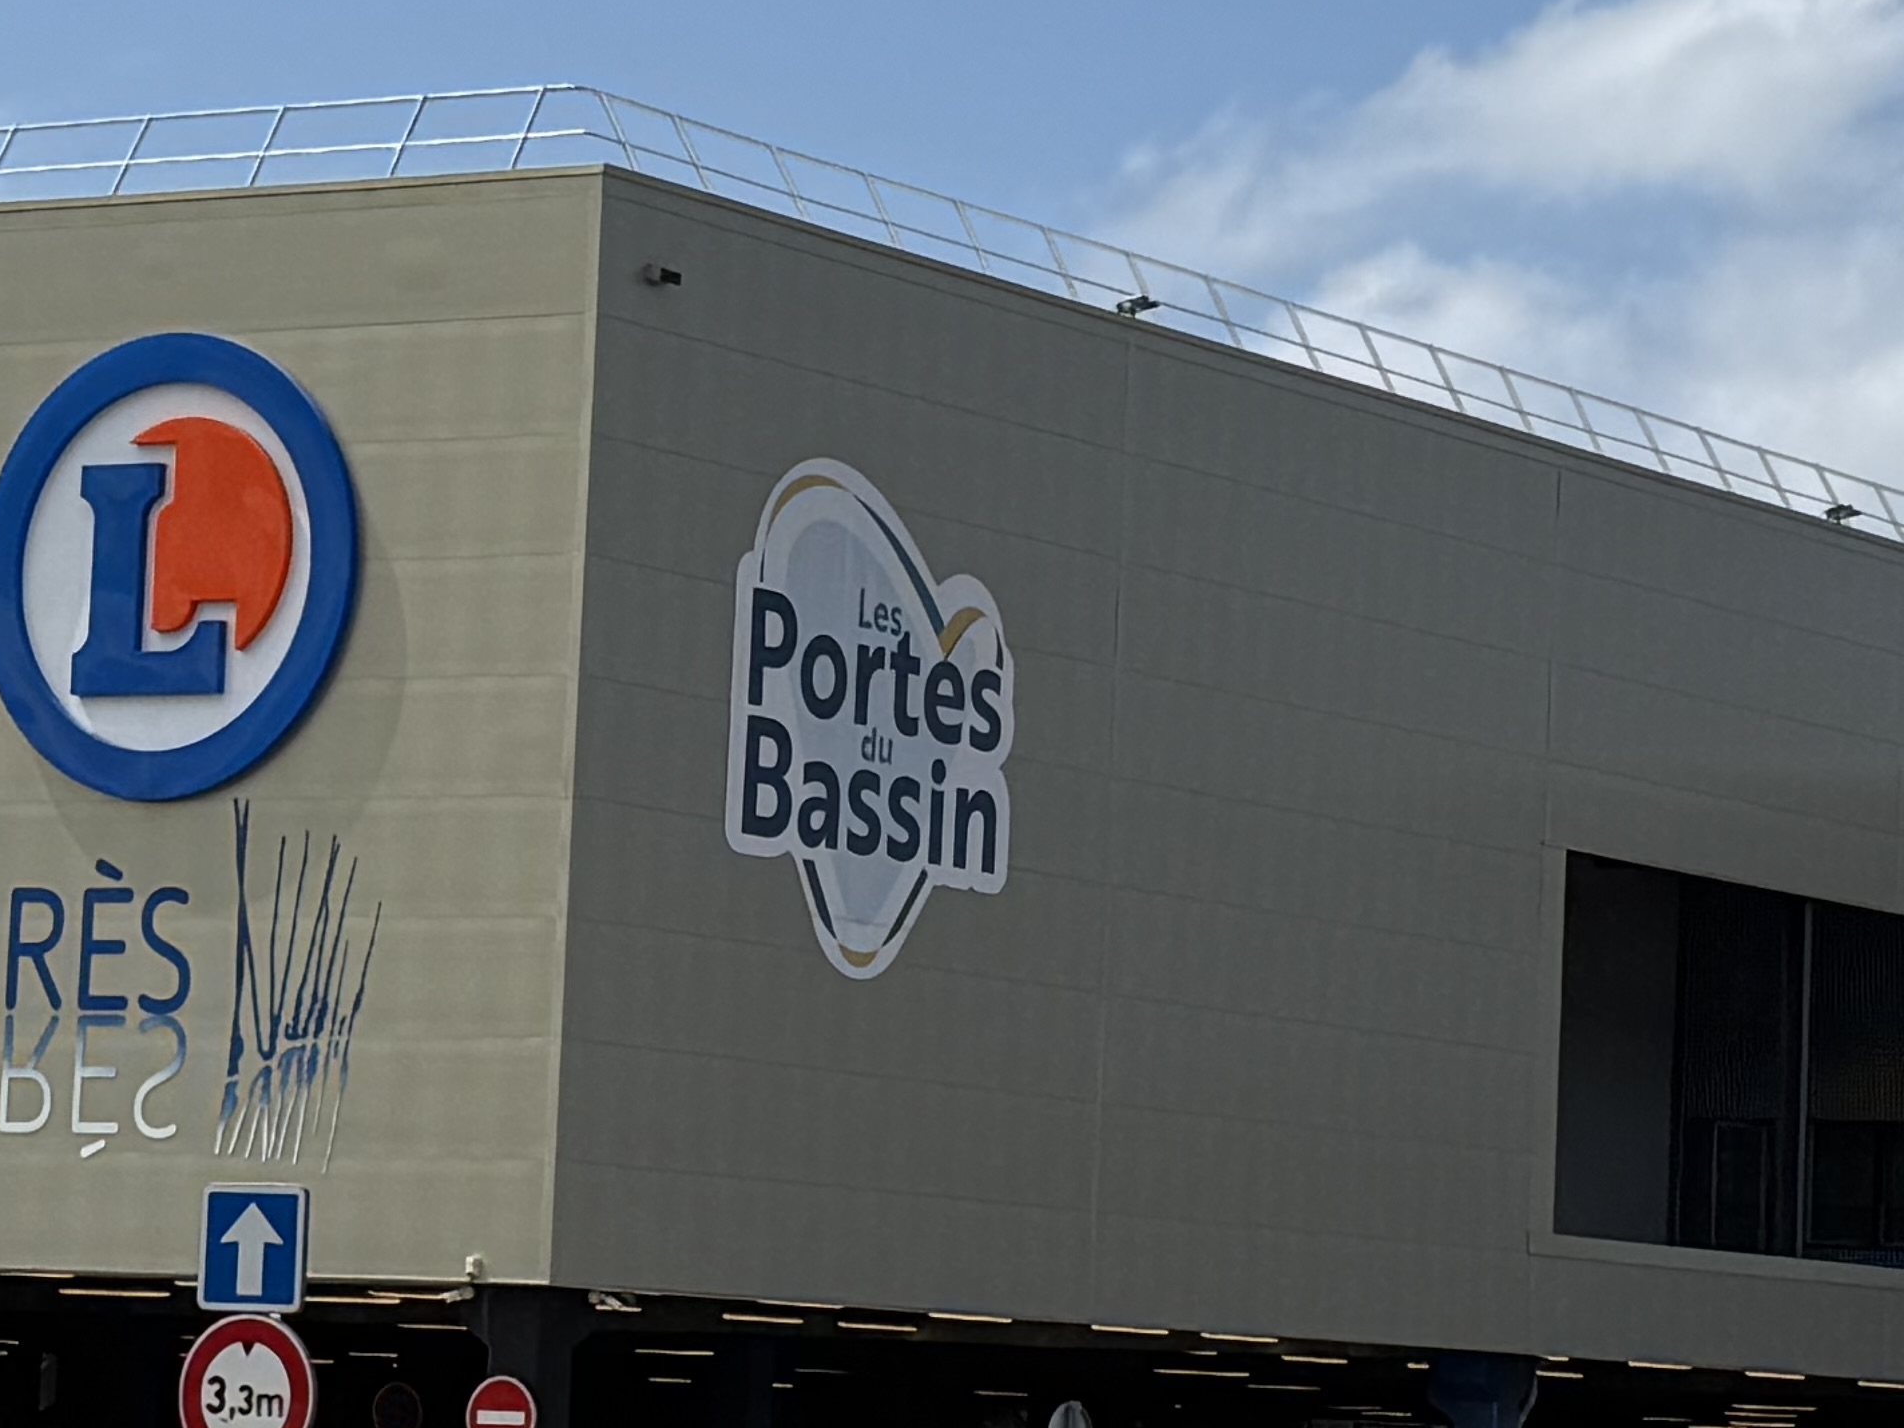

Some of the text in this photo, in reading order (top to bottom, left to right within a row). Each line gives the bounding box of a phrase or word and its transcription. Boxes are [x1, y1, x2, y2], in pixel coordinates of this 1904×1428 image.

[71, 463, 226, 696] L
[858, 587, 903, 636] Les
[748, 587, 1002, 752] Portes
[741, 714, 997, 875] Bassin
[860, 727, 893, 765] du
[205, 1375, 284, 1420] 3,3m
